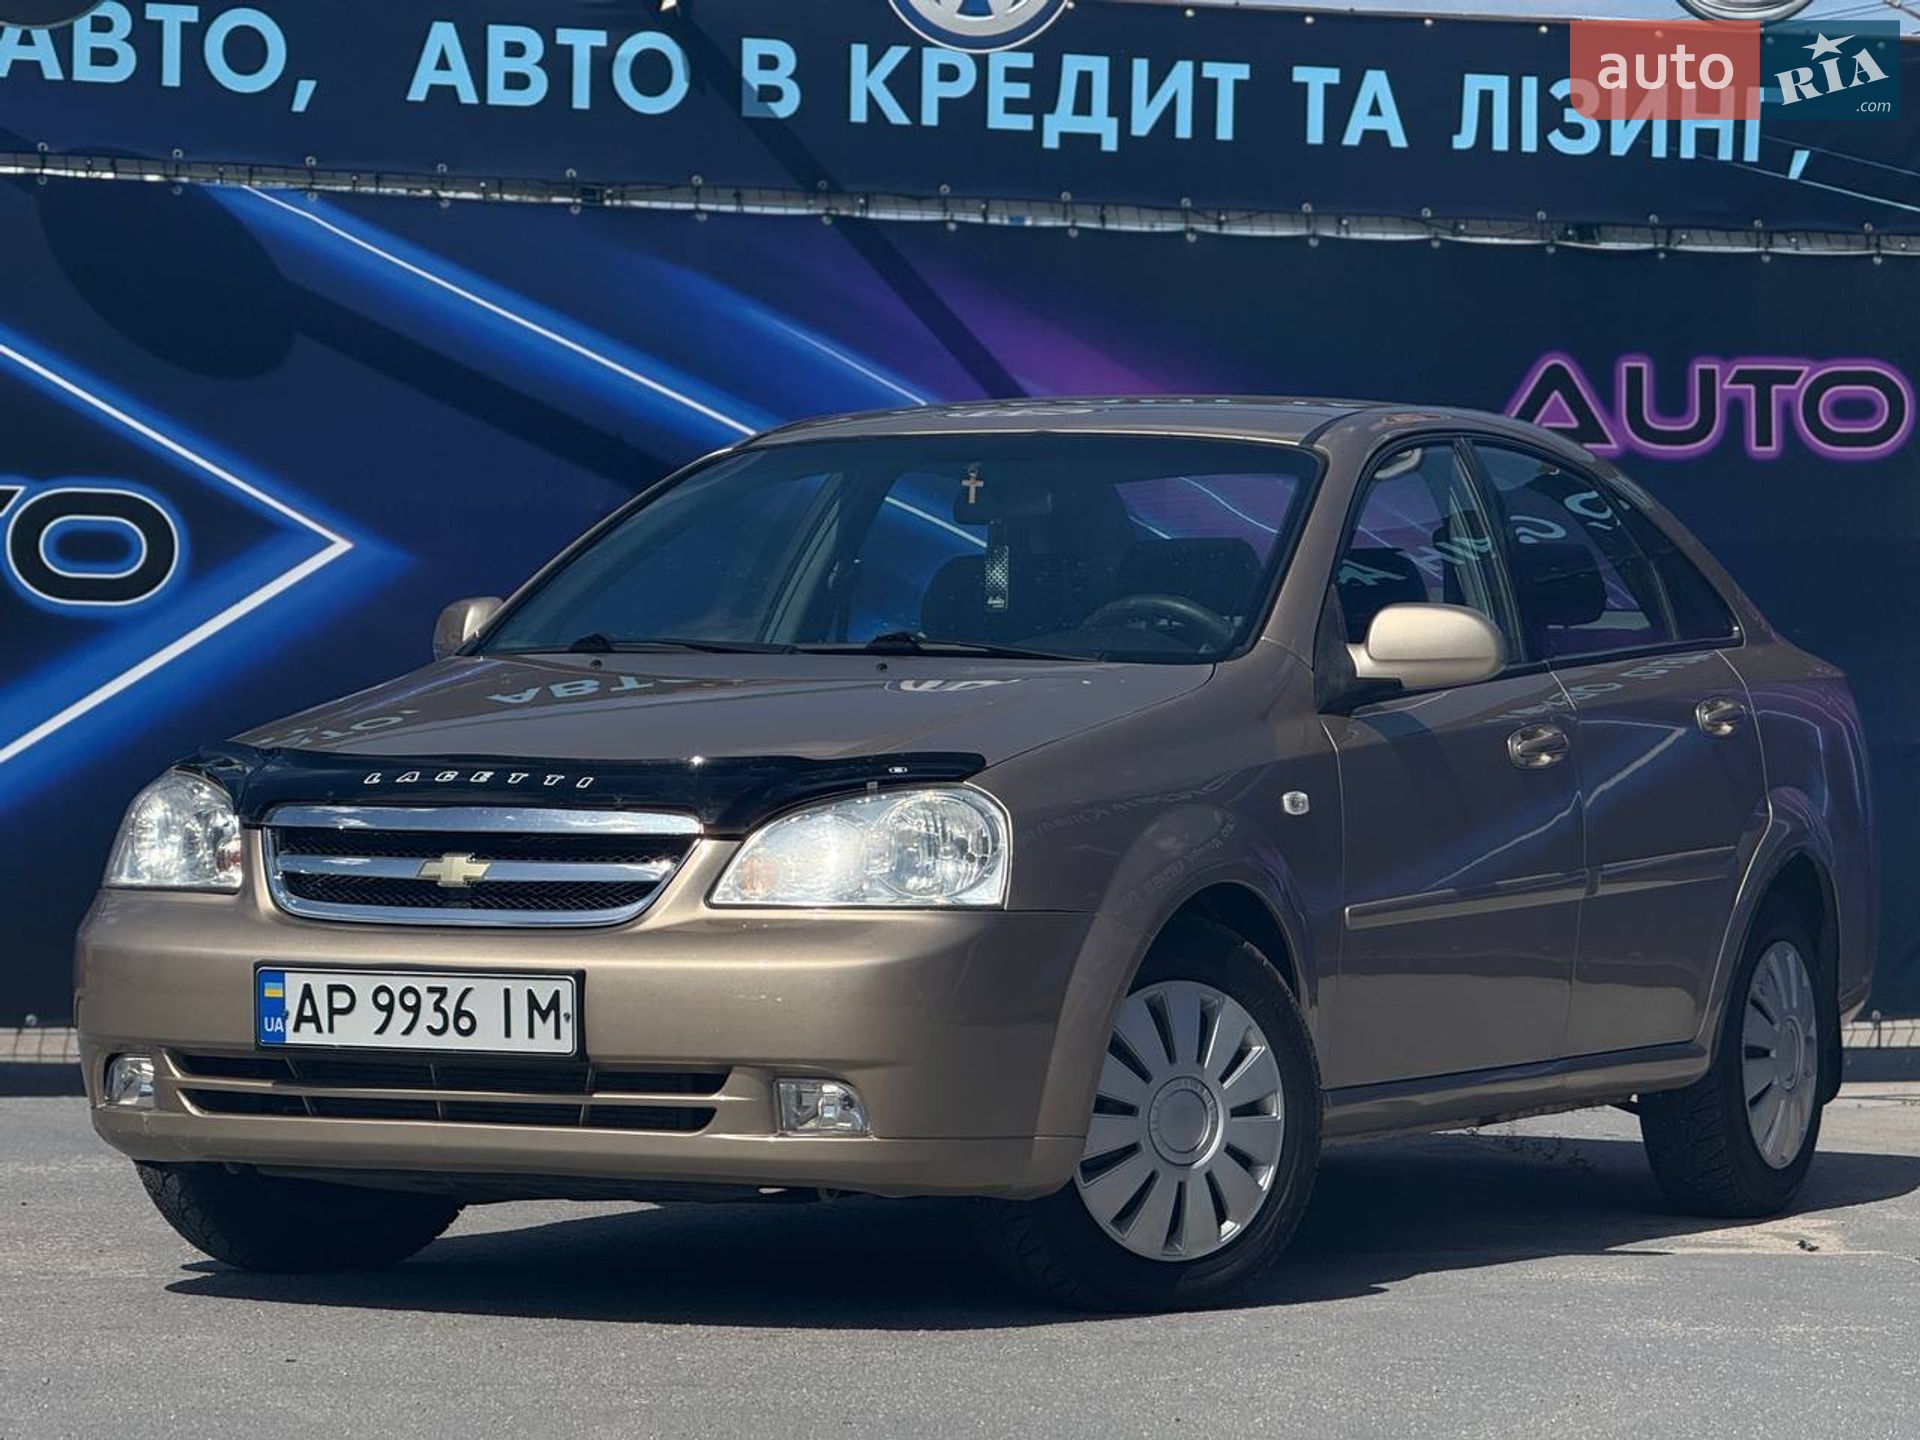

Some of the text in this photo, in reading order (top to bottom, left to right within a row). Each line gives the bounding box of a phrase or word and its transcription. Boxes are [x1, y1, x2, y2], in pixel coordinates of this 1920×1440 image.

[0, 1, 316, 112] АВТО,
[406, 21, 690, 115] АВТО
[741, 38, 801, 118] В
[849, 43, 1250, 151] КРЕДИТ
[1293, 66, 1408, 148] ТА
[1508, 357, 1909, 452] AUTO
[363, 771, 594, 788] LACETTI
[264, 1016, 284, 1032] UA
[292, 983, 561, 1040] AP 9936 IM
